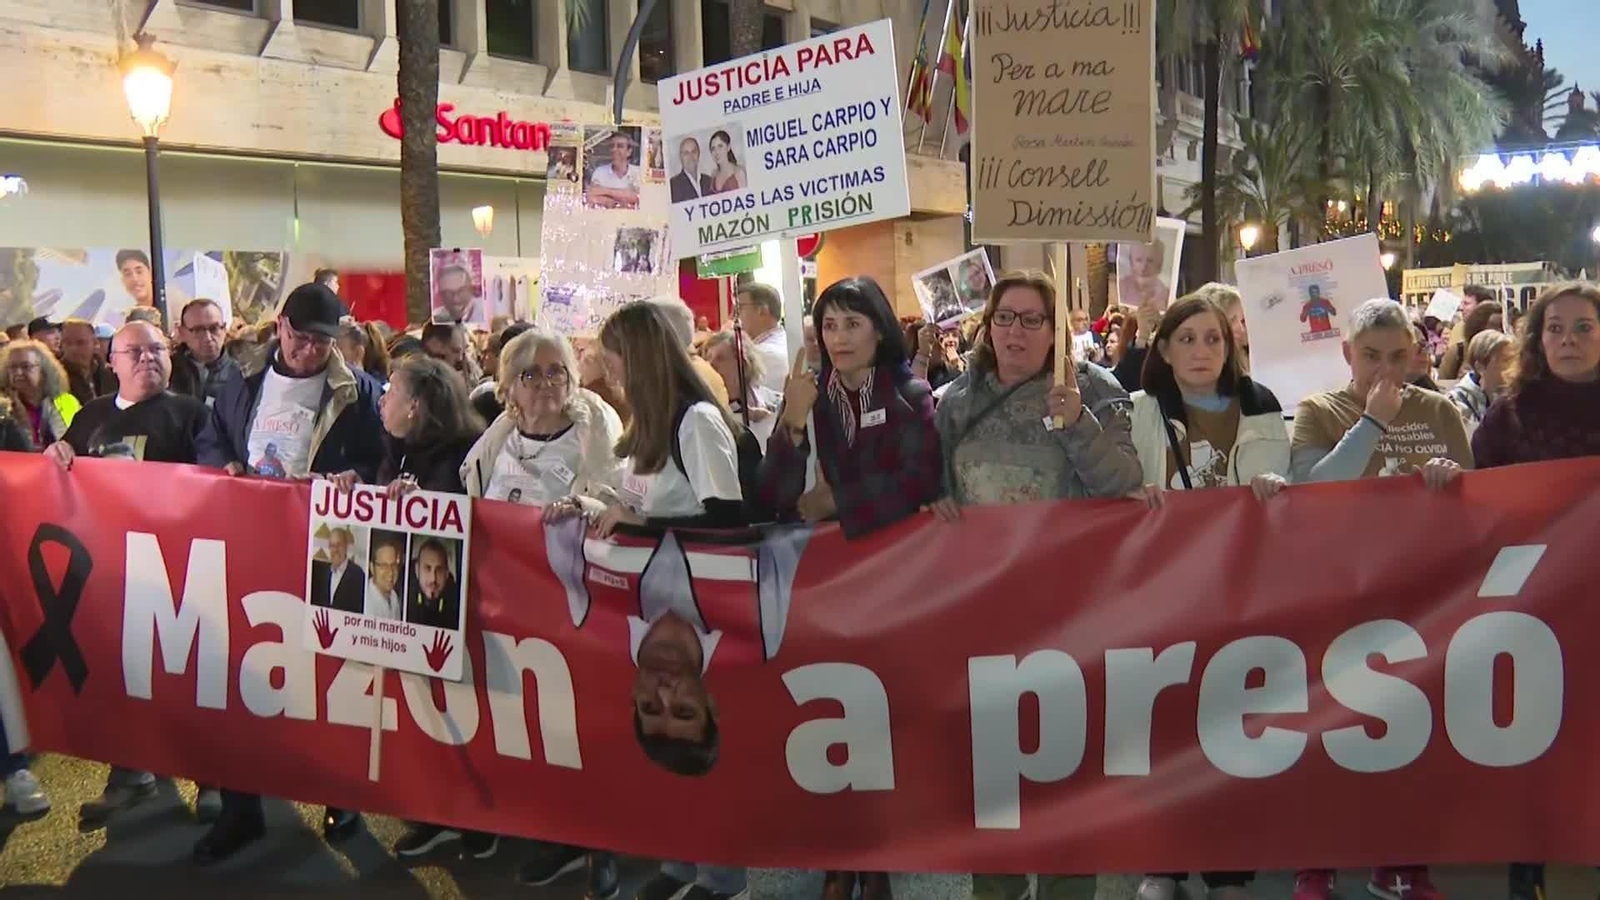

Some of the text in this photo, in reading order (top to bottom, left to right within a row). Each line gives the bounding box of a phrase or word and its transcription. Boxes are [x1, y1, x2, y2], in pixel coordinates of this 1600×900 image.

[673, 32, 875, 106] JUSTICIA PARA
[991, 52, 1115, 83] Per a ma
[723, 77, 821, 113] PADRE E HIJA
[1013, 88, 1112, 117] mare
[436, 103, 552, 152] Santan
[746, 96, 892, 147] MIGUEL CARPIO Y
[764, 129, 877, 170] SARA CARPIO
[684, 166, 886, 222] Y TODAS LAS VICTIMAS
[698, 192, 873, 244] MAZÓN PRISIÓN
[1386, 421, 1430, 433] llecidos
[315, 485, 464, 534] JUSTICIA
[344, 615, 417, 638] por mi marido
[352, 634, 407, 653] y mis hijos
[781, 661, 896, 794] a
[968, 544, 1565, 830] presó
